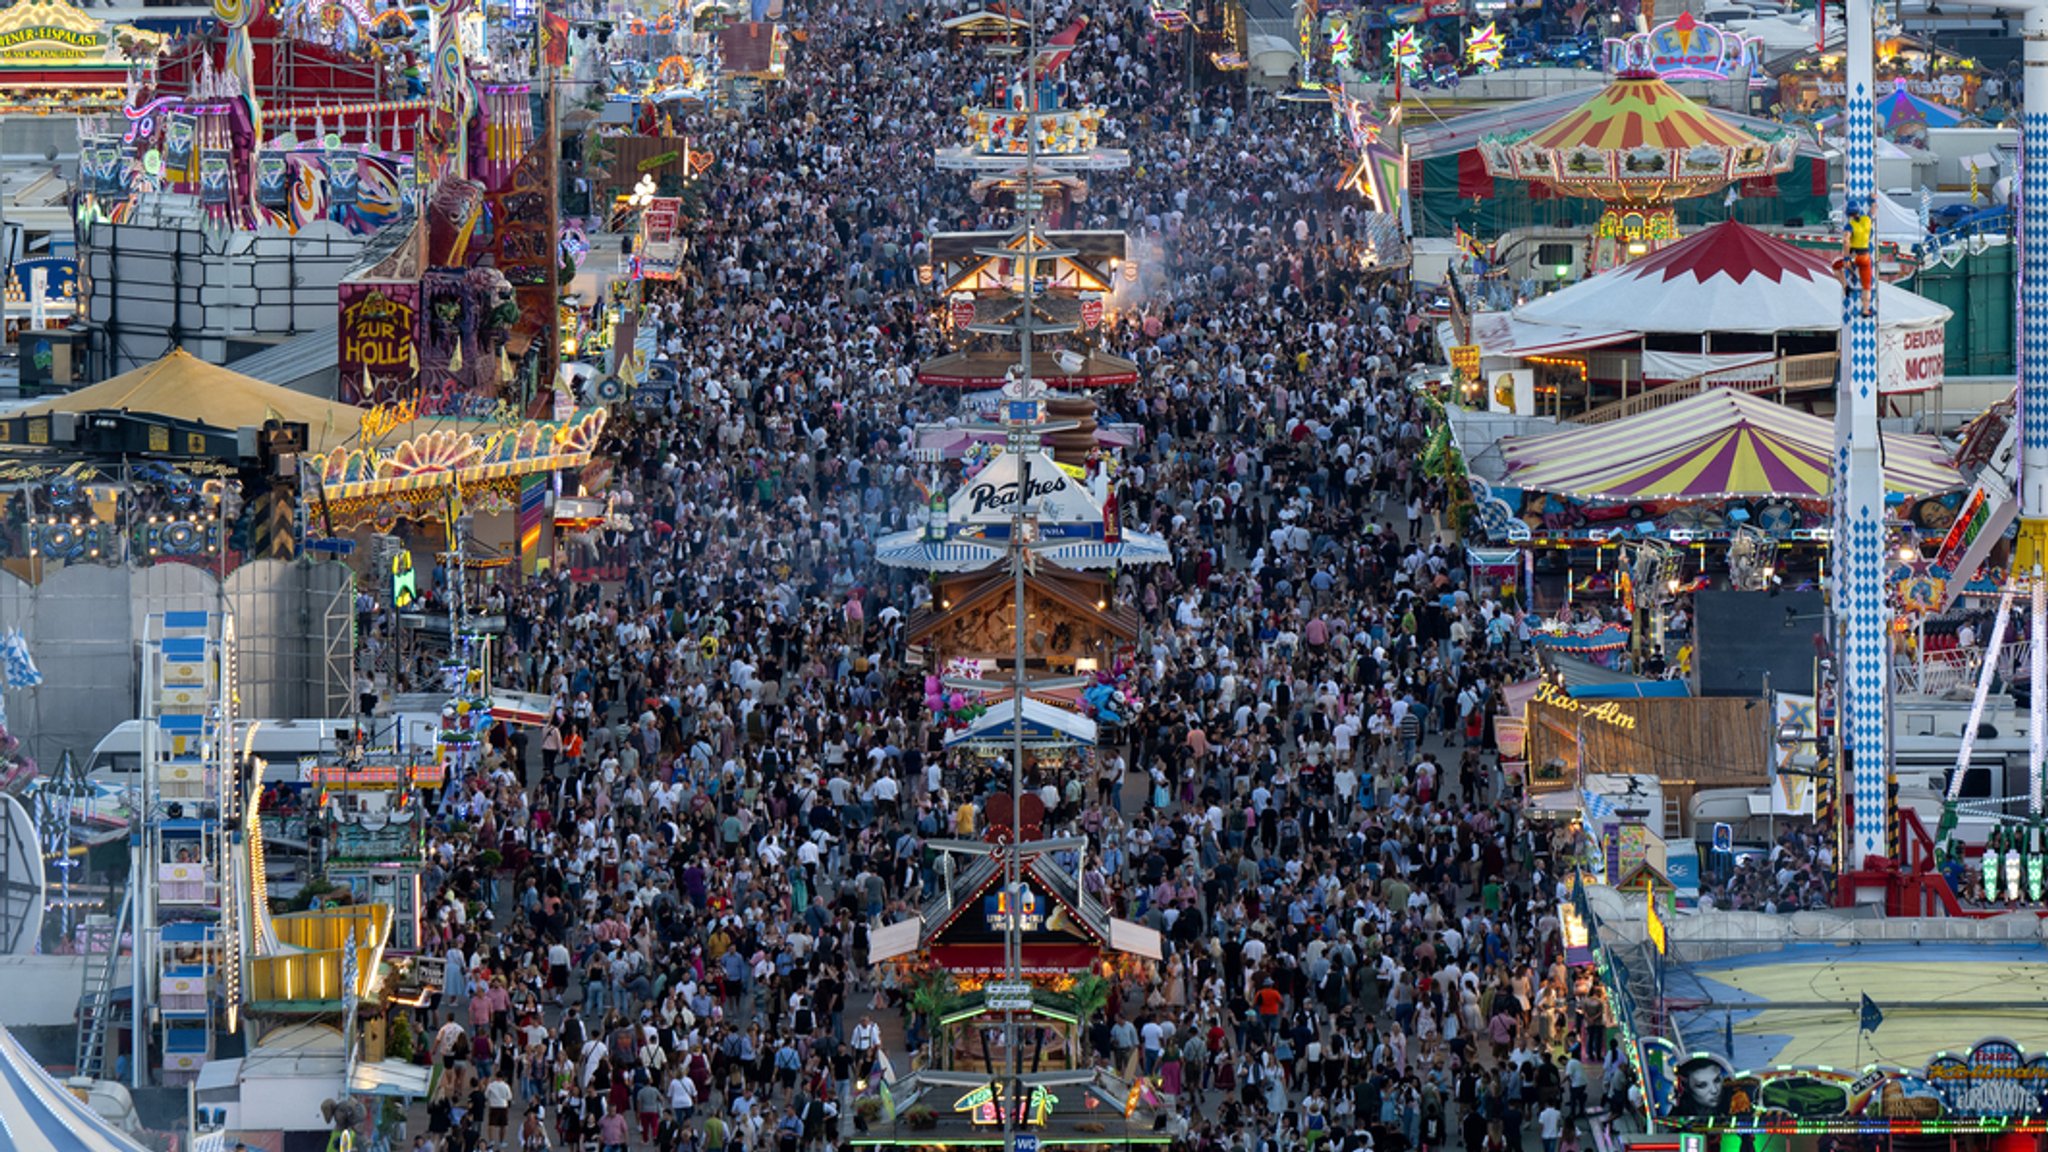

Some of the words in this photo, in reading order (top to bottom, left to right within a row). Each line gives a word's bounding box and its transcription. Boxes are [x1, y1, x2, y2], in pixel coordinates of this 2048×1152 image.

[1656, 55, 1717, 65] SHOP
[357, 322, 396, 339] ZUR
[969, 476, 1067, 515] Peahes
[1017, 1138, 1036, 1150] WC
